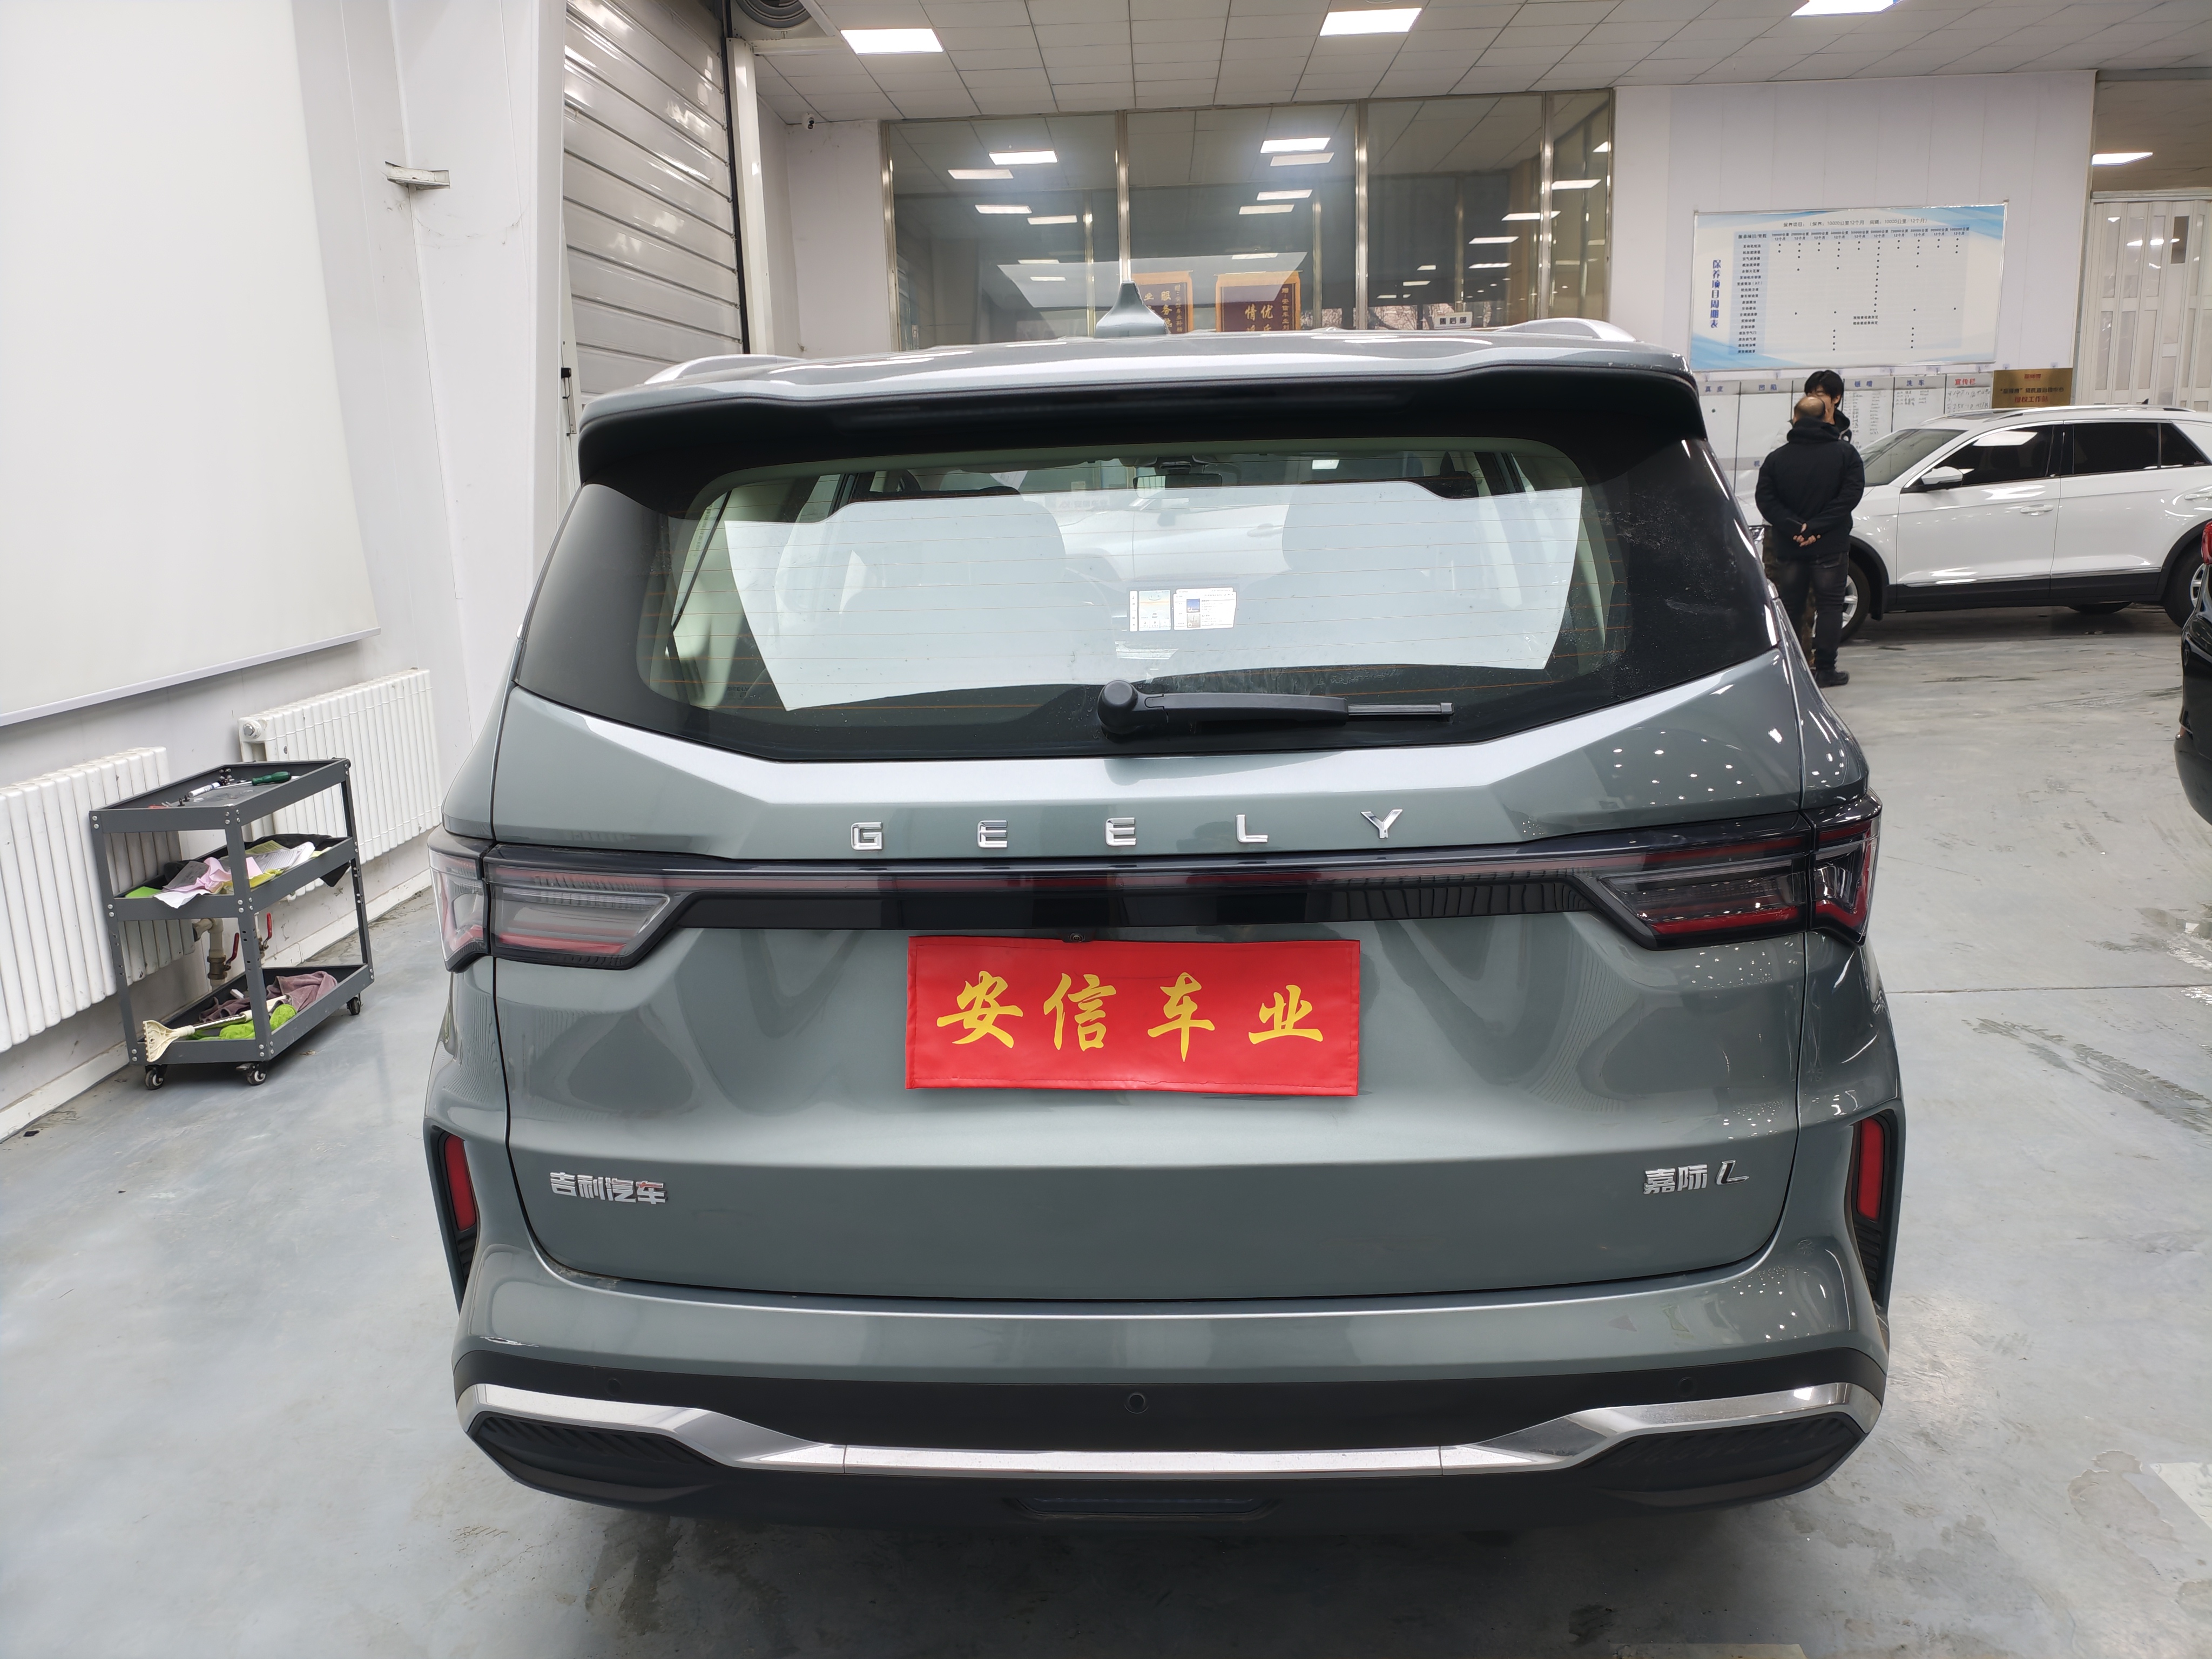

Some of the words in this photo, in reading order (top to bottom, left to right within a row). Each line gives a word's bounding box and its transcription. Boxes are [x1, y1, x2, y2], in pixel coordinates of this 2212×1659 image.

[1710, 259, 1721, 328] 保养项目周期表
[851, 809, 1403, 851] GEELY
[936, 970, 1324, 1062] 安信车业
[550, 1172, 667, 1204] 吉利汽车
[1643, 1163, 1708, 1195] 嘉际
